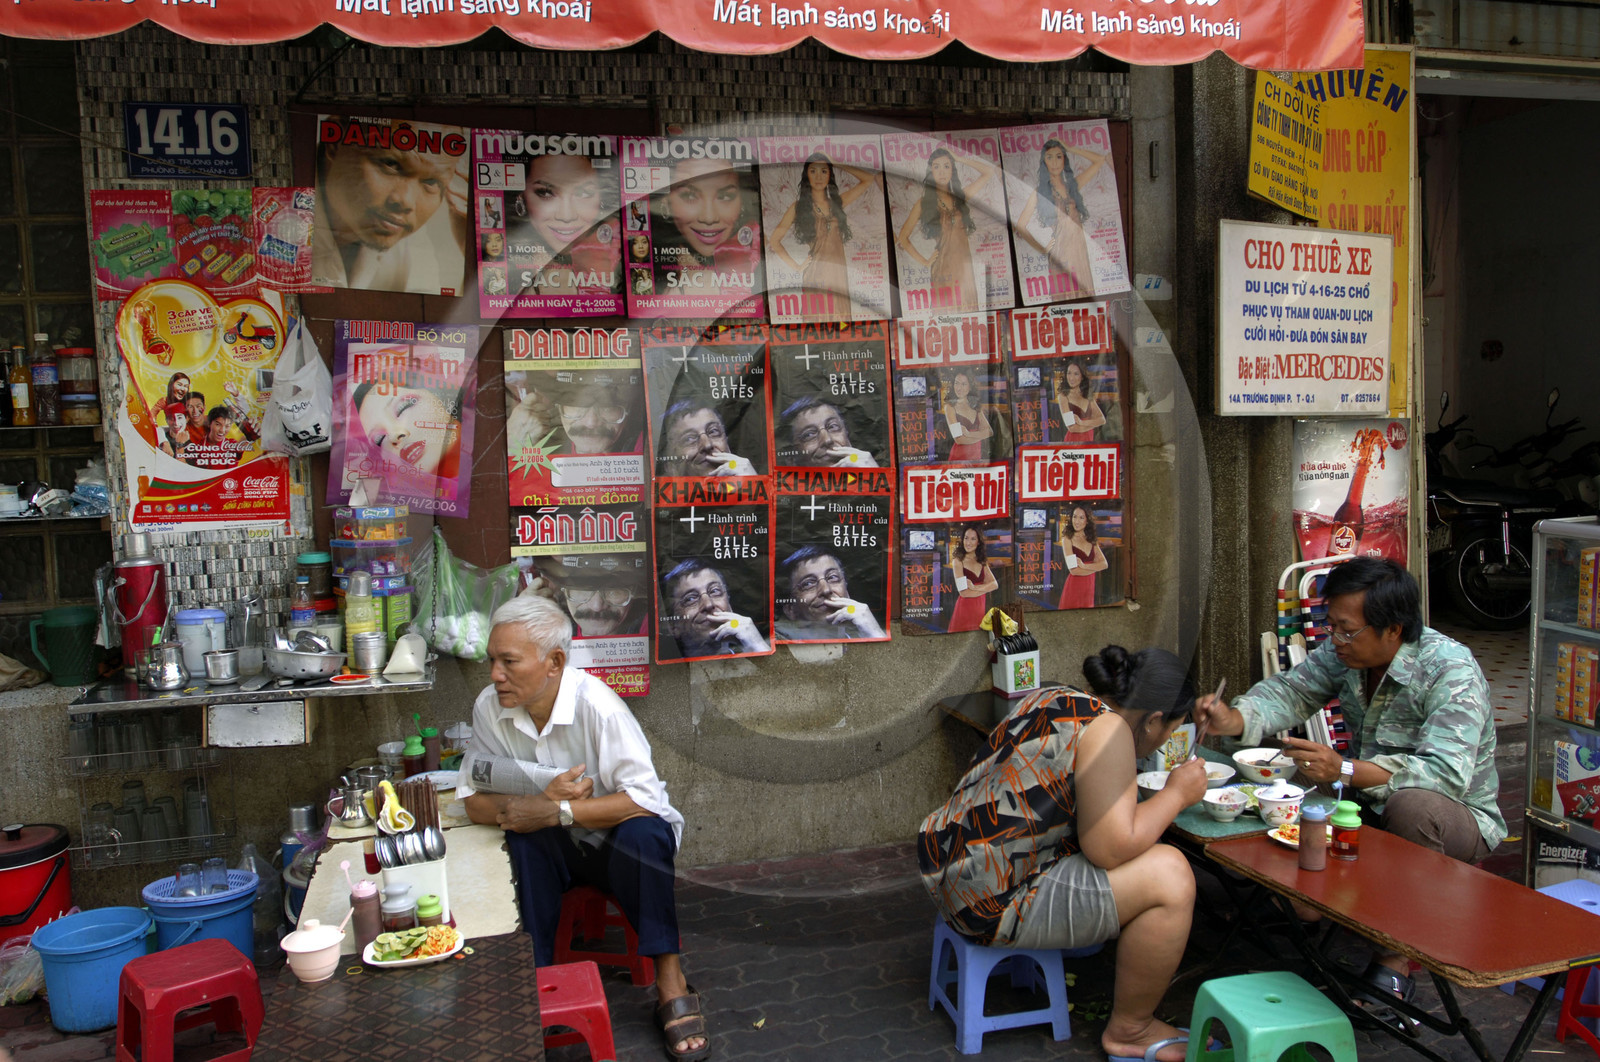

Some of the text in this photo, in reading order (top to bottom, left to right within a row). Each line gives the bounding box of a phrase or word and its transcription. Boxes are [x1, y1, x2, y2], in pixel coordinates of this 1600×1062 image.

[713, 0, 762, 26] Mát
[771, 2, 818, 29] lạnh
[824, 6, 876, 31] sảng
[1040, 8, 1241, 40] Mát lạnh sảng khoái
[1294, 68, 1408, 113] HUYÊN
[1264, 81, 1320, 124] CH DỜI VỀ
[1356, 120, 1387, 173] CẤP
[516, 246, 548, 254] MODEL
[1244, 238, 1372, 276] CHO THUÊ XE
[521, 266, 616, 288] SẮC MÀU
[666, 266, 704, 288] SẮC
[710, 269, 756, 288] MÀU
[1026, 266, 1079, 298] mini
[1245, 279, 1346, 298] DU LỊCH TỪ 4-16-25
[906, 280, 962, 310] mini
[489, 298, 616, 308] PHÁT HÀNH NGÀY 5-4-2006
[636, 298, 756, 308] PHÁT HÀNH NGÀY 5-4-2006
[776, 288, 834, 316] mini
[168, 310, 177, 320] 3
[1050, 307, 1072, 316] Saigon
[1242, 304, 1373, 324] PHỤC VỤ THAM LỊCH
[938, 315, 962, 324] Saigon
[417, 328, 466, 344] BỘ MỚI
[1014, 306, 1106, 354] Tiếp thị
[1244, 324, 1368, 344] CƯỚI ĐÓN SÂN BAY
[900, 315, 997, 362] Tiếp thị
[232, 344, 262, 354] 15 XE
[702, 352, 754, 364] Hành trình
[822, 350, 873, 361] Hành trình
[752, 366, 764, 374] của
[870, 362, 885, 370] của
[1238, 356, 1270, 386] Đặc Biệt
[709, 376, 747, 388] BILL
[829, 372, 867, 384] BILL
[712, 386, 754, 399] GATES
[831, 382, 876, 396] GATES
[1229, 394, 1241, 404] 14A
[1270, 394, 1286, 406] ĐỊNH
[1355, 394, 1380, 402] 8257864
[519, 454, 544, 464] 4/2006
[1062, 452, 1085, 461] Saigon
[1300, 460, 1346, 472] Nửa dịu nhẹ
[950, 470, 974, 480] Saigon
[1024, 450, 1115, 498] Tiếp thị
[1298, 472, 1314, 482] Nửa
[910, 468, 1005, 517] Tiếp thị
[397, 495, 457, 513] 5/4/2006
[828, 502, 878, 513] Hành trình
[708, 512, 758, 524] Hành trình
[874, 516, 888, 525] của
[754, 526, 768, 534] của
[832, 526, 869, 536] BILL
[713, 536, 750, 548] BILL
[834, 536, 877, 547] GATES
[714, 546, 758, 560] GATES
[1540, 842, 1587, 862] Energizer
